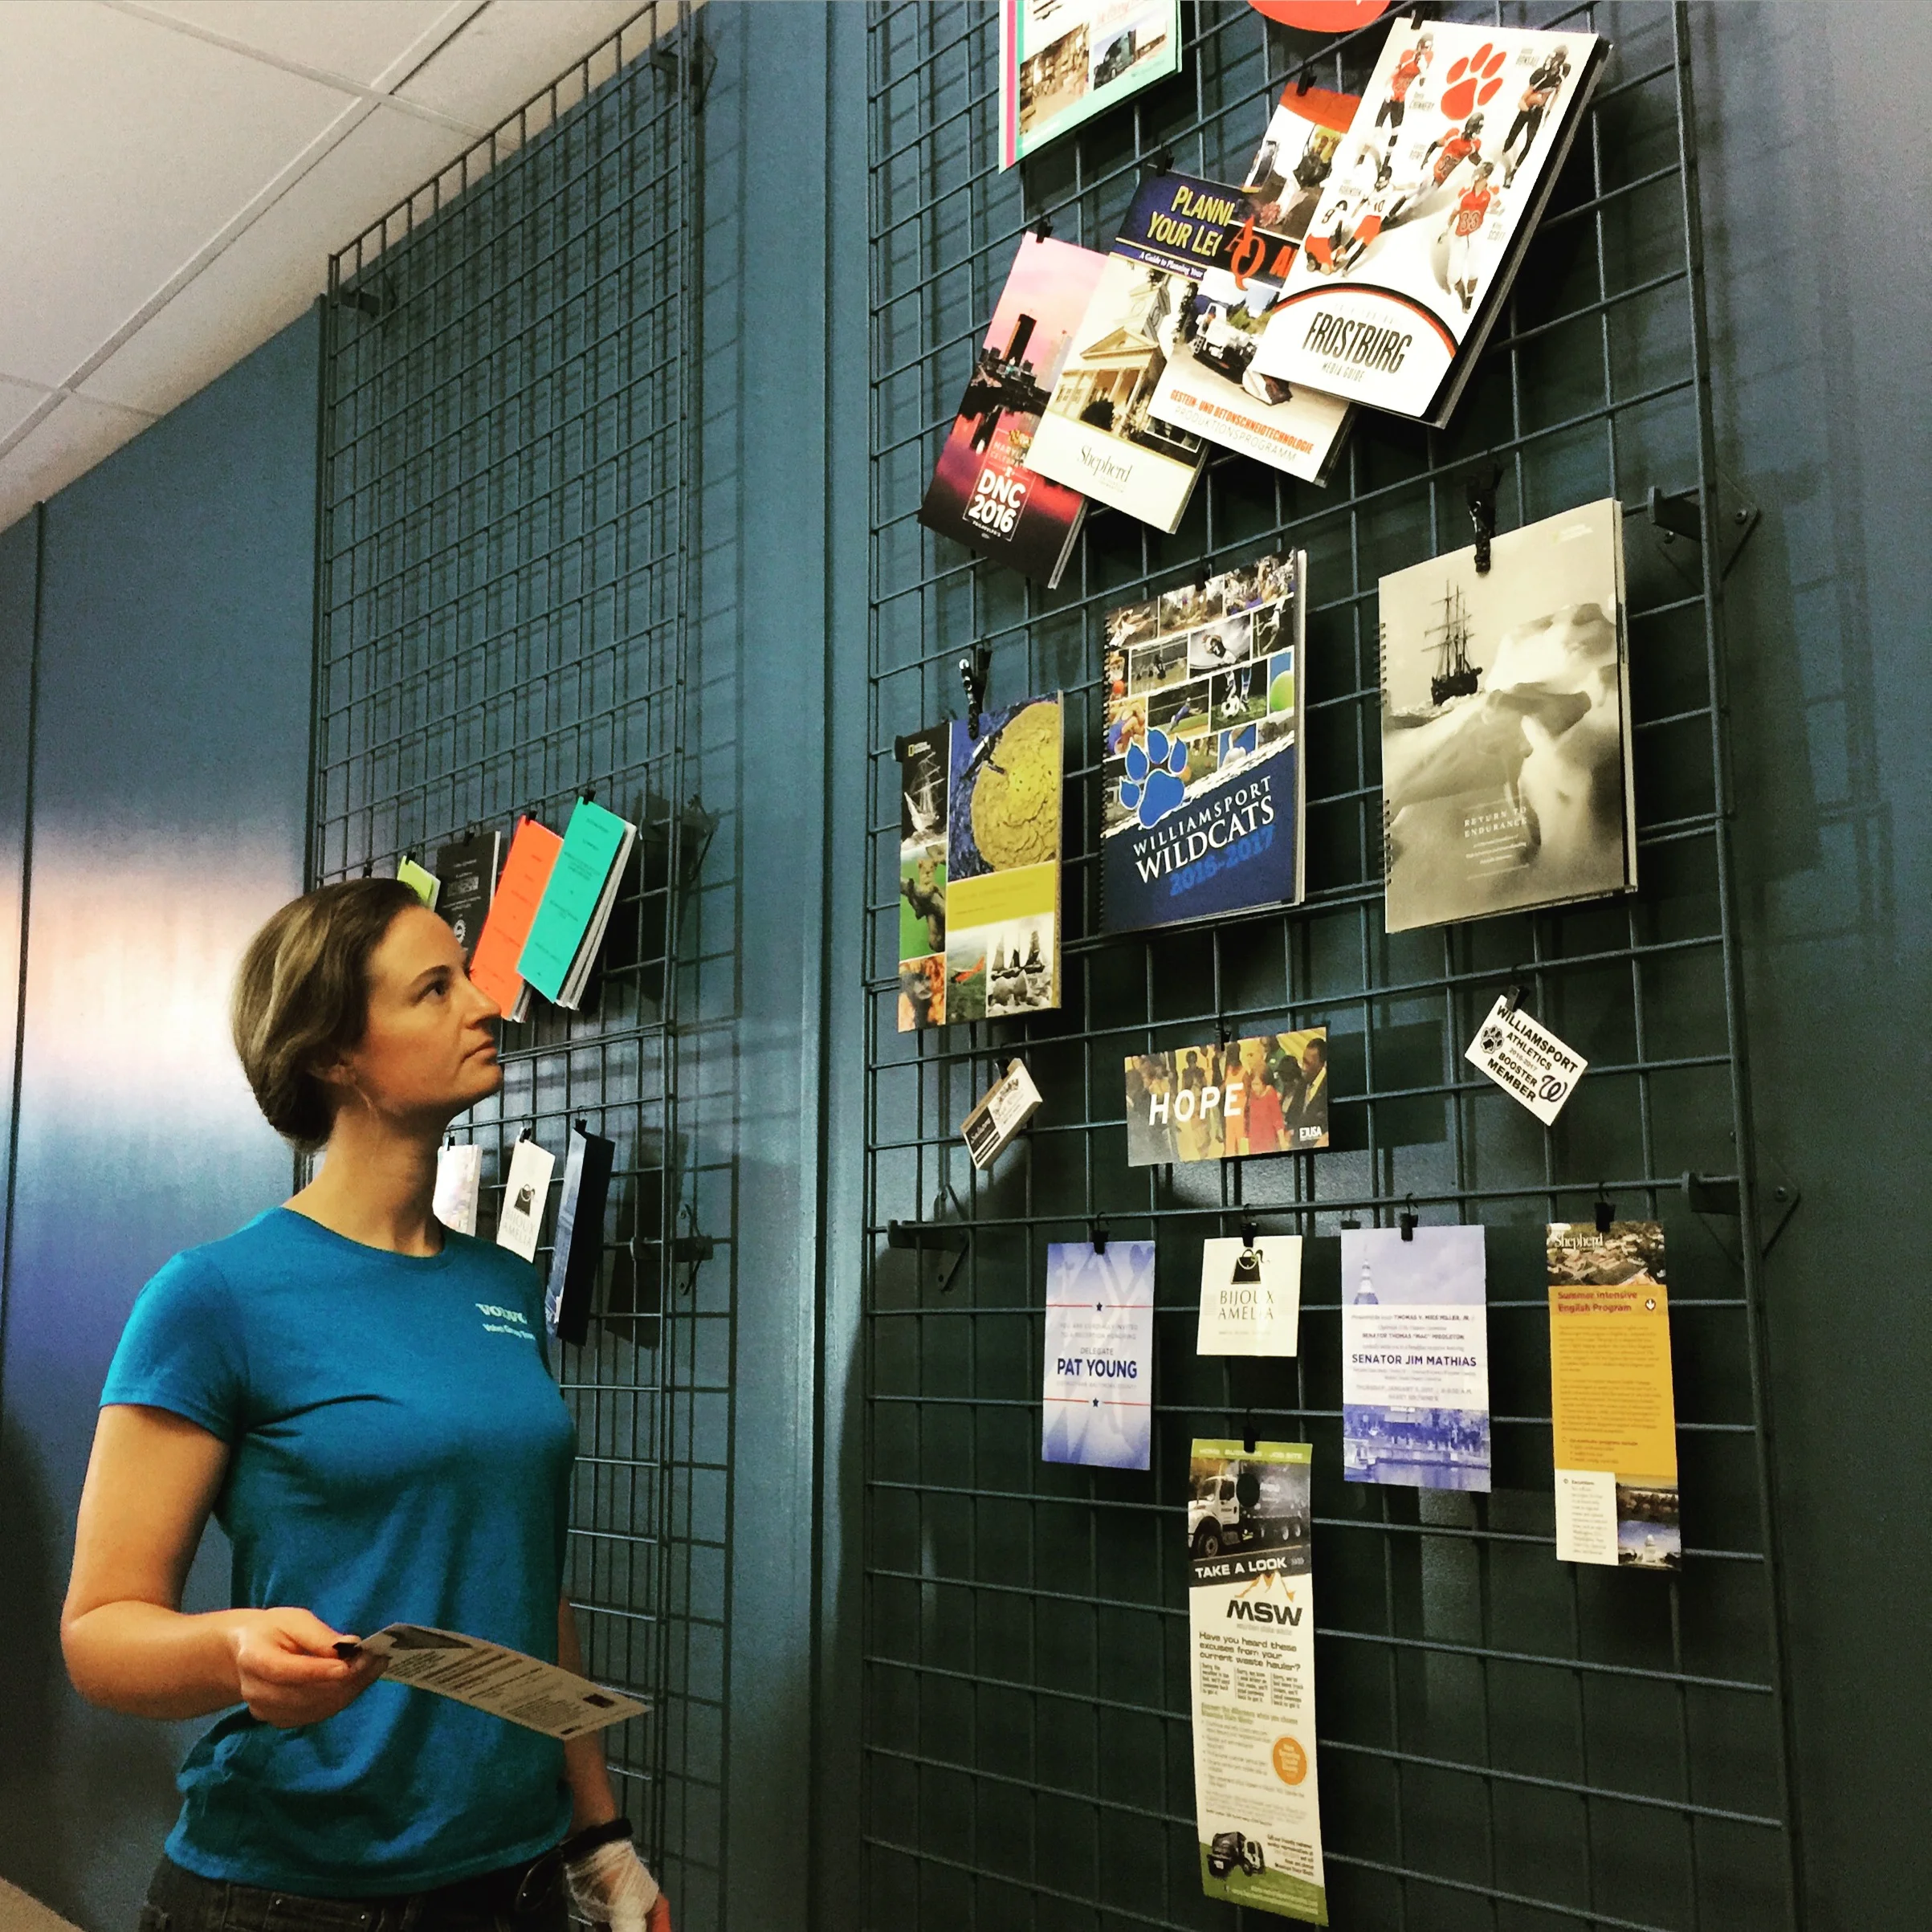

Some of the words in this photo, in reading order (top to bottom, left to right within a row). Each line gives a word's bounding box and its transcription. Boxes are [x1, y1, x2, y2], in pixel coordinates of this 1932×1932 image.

[1147, 210, 1192, 249] YOUR
[1302, 312, 1412, 374] FROSTBURG
[1198, 401, 1214, 415] UND
[1077, 444, 1134, 483] Shepherd
[976, 468, 1026, 509] DNC
[968, 494, 1017, 534] 2016
[1133, 775, 1272, 857] WILLIAMSPORT
[1464, 809, 1507, 827] RETURN
[1513, 805, 1527, 816] TO
[1464, 817, 1527, 838] ENDURANCE
[1135, 795, 1275, 884] WILDCATS
[1497, 1005, 1579, 1074] WILLIAMSPORT
[1506, 1032, 1552, 1071] ATHLETICS
[1487, 1058, 1537, 1103] MEMBER
[1498, 1052, 1539, 1087] BOOSTER
[1148, 1082, 1245, 1126] HOPE
[1299, 1125, 1323, 1138] EJUSA
[1554, 1232, 1604, 1250] Shepherd
[1593, 1303, 1632, 1314] Program
[1080, 1347, 1115, 1356] DELEGATE
[1351, 1354, 1402, 1364] SENATOR
[1405, 1355, 1423, 1365] JIM
[1426, 1355, 1477, 1367] MATHIAS
[1057, 1358, 1083, 1376] PAT
[1086, 1359, 1138, 1379] YOUNG
[1195, 1565, 1231, 1579] TAKE
[1234, 1563, 1245, 1574] A
[1248, 1556, 1288, 1572] LOOK
[1226, 1600, 1303, 1627] MSW
[1199, 1632, 1221, 1641] Have
[1223, 1636, 1239, 1644] you
[1241, 1637, 1268, 1649] heard
[1270, 1642, 1298, 1652] these
[1199, 1642, 1234, 1653] excuses
[1237, 1646, 1259, 1656] from
[1262, 1650, 1282, 1660] your
[1199, 1652, 1233, 1662] current
[1235, 1657, 1264, 1667] waste
[1266, 1660, 1301, 1672] hauler?
